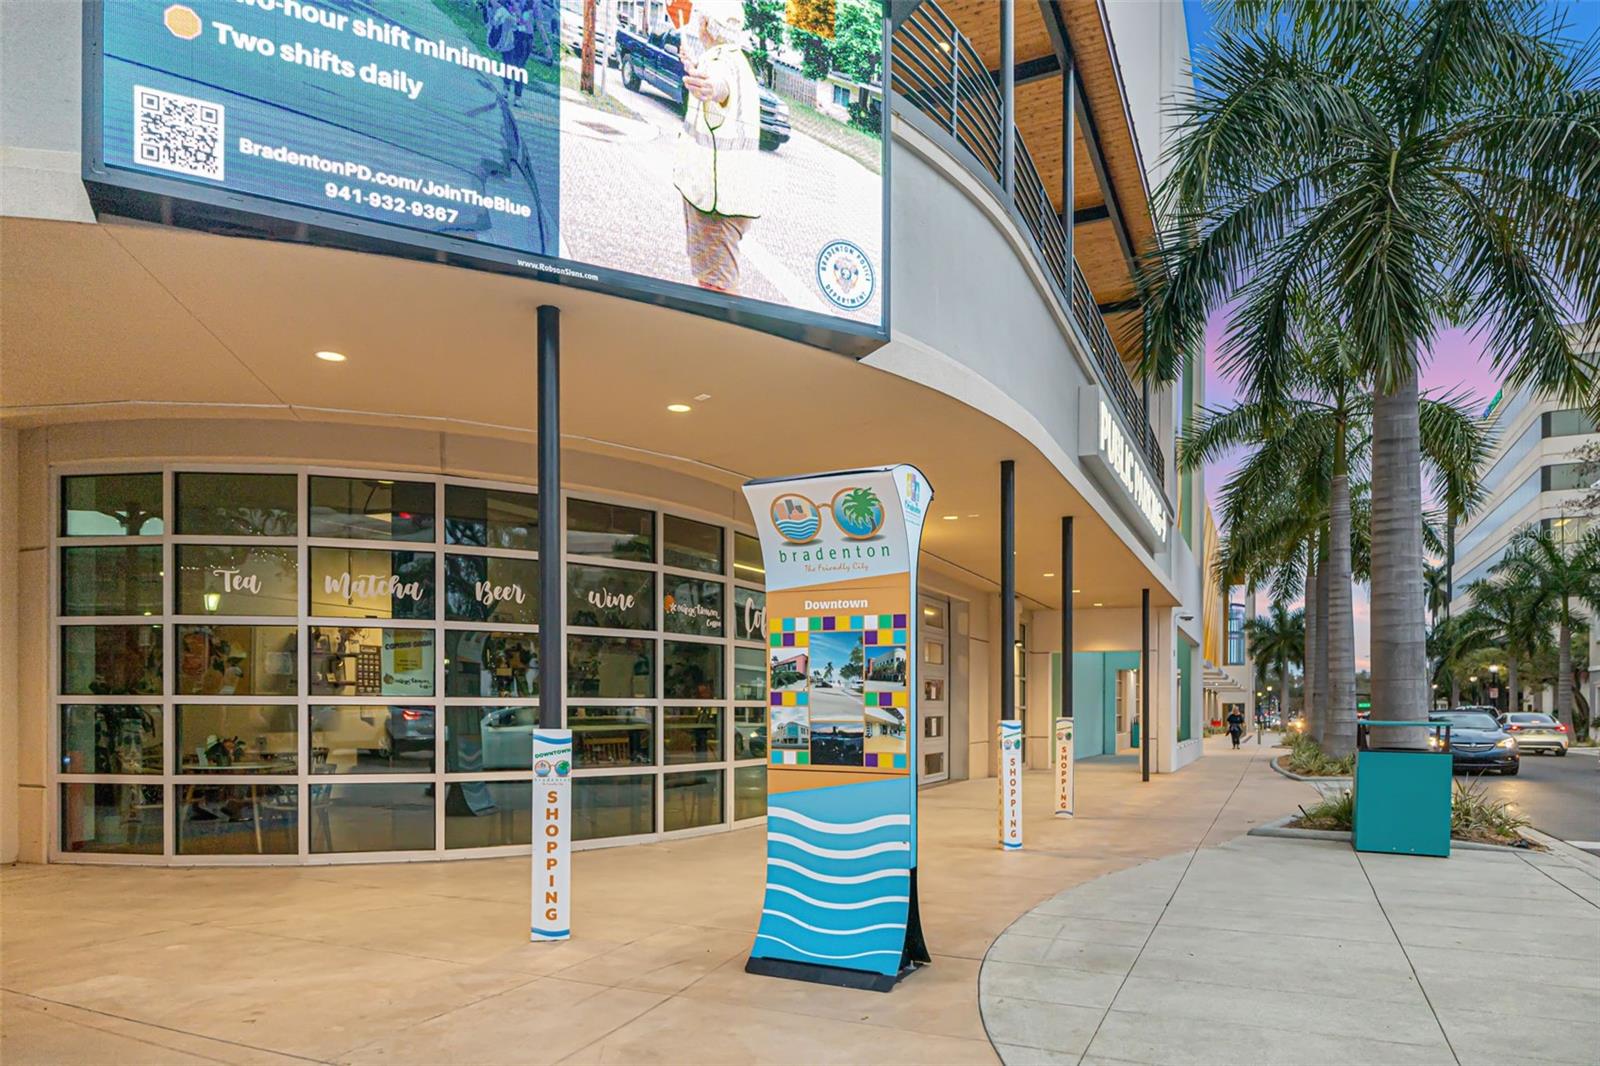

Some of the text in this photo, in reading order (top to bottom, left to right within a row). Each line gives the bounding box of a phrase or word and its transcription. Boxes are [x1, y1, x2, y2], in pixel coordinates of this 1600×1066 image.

[212, 21, 423, 99] Two shifts daily
[352, 18, 411, 50] shift
[415, 37, 528, 84] minimum
[239, 138, 531, 218] BradentonPD.com/JoinTheBlue
[325, 182, 458, 224] 941-932-9367
[1100, 400, 1133, 494] PUBLIC
[778, 545, 890, 563] bradenton
[213, 569, 262, 594] Tea
[324, 572, 424, 600] Matcha
[475, 581, 525, 605] Beer
[804, 599, 868, 610] Downtown
[535, 748, 571, 759] DOWNTOWN
[1060, 746, 1068, 809] SHOPPING
[1009, 758, 1017, 838] SHOPPING
[545, 790, 559, 921] SHOPPING
